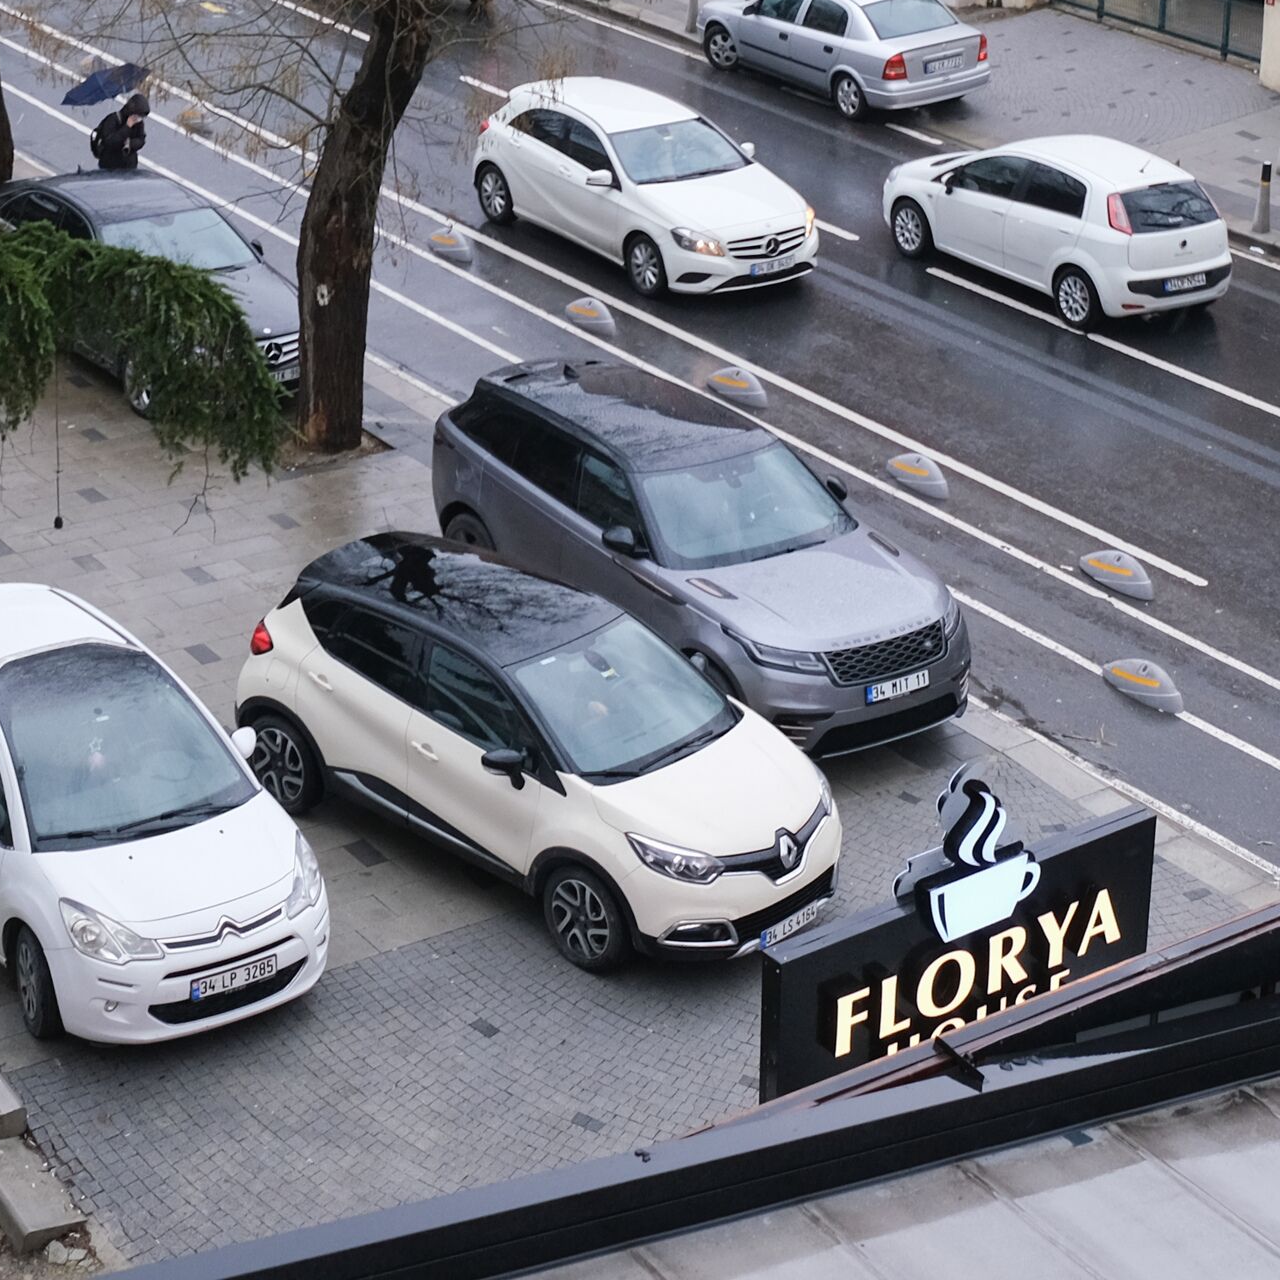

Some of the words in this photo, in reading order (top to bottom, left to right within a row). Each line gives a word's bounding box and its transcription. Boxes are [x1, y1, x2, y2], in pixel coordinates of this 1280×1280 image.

[873, 685, 886, 699] 34
[892, 677, 909, 693] MIT
[916, 672, 926, 686] 11
[766, 928, 778, 944] 34
[782, 918, 793, 935] LS
[200, 979, 216, 995] 34
[222, 972, 237, 989] LP
[244, 959, 273, 982] 3285
[833, 887, 1121, 1058] FLORYA
